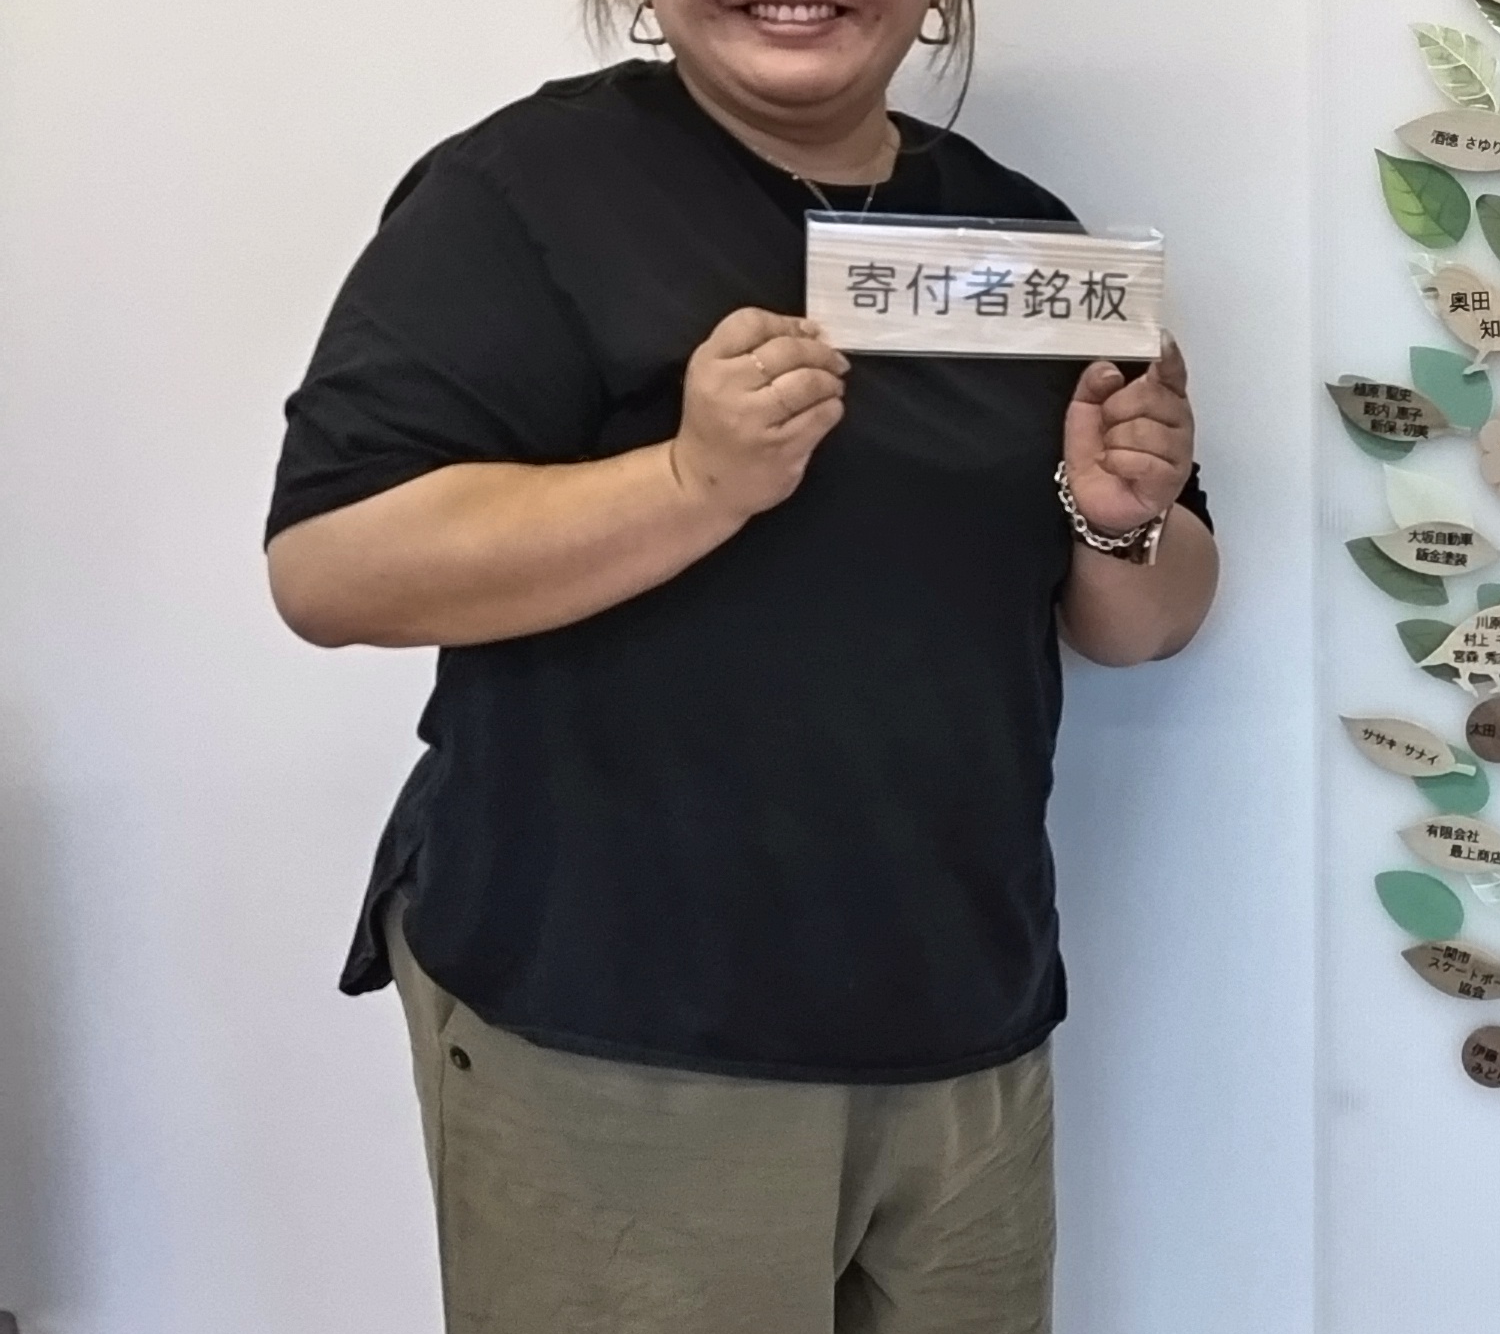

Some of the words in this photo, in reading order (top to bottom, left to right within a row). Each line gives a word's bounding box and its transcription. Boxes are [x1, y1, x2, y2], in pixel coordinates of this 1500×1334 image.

[847, 262, 1128, 321] 寄付者銘板
[1450, 292, 1490, 312] 奥田
[1363, 729, 1396, 749] ササキ
[1405, 745, 1438, 765] サナイ
